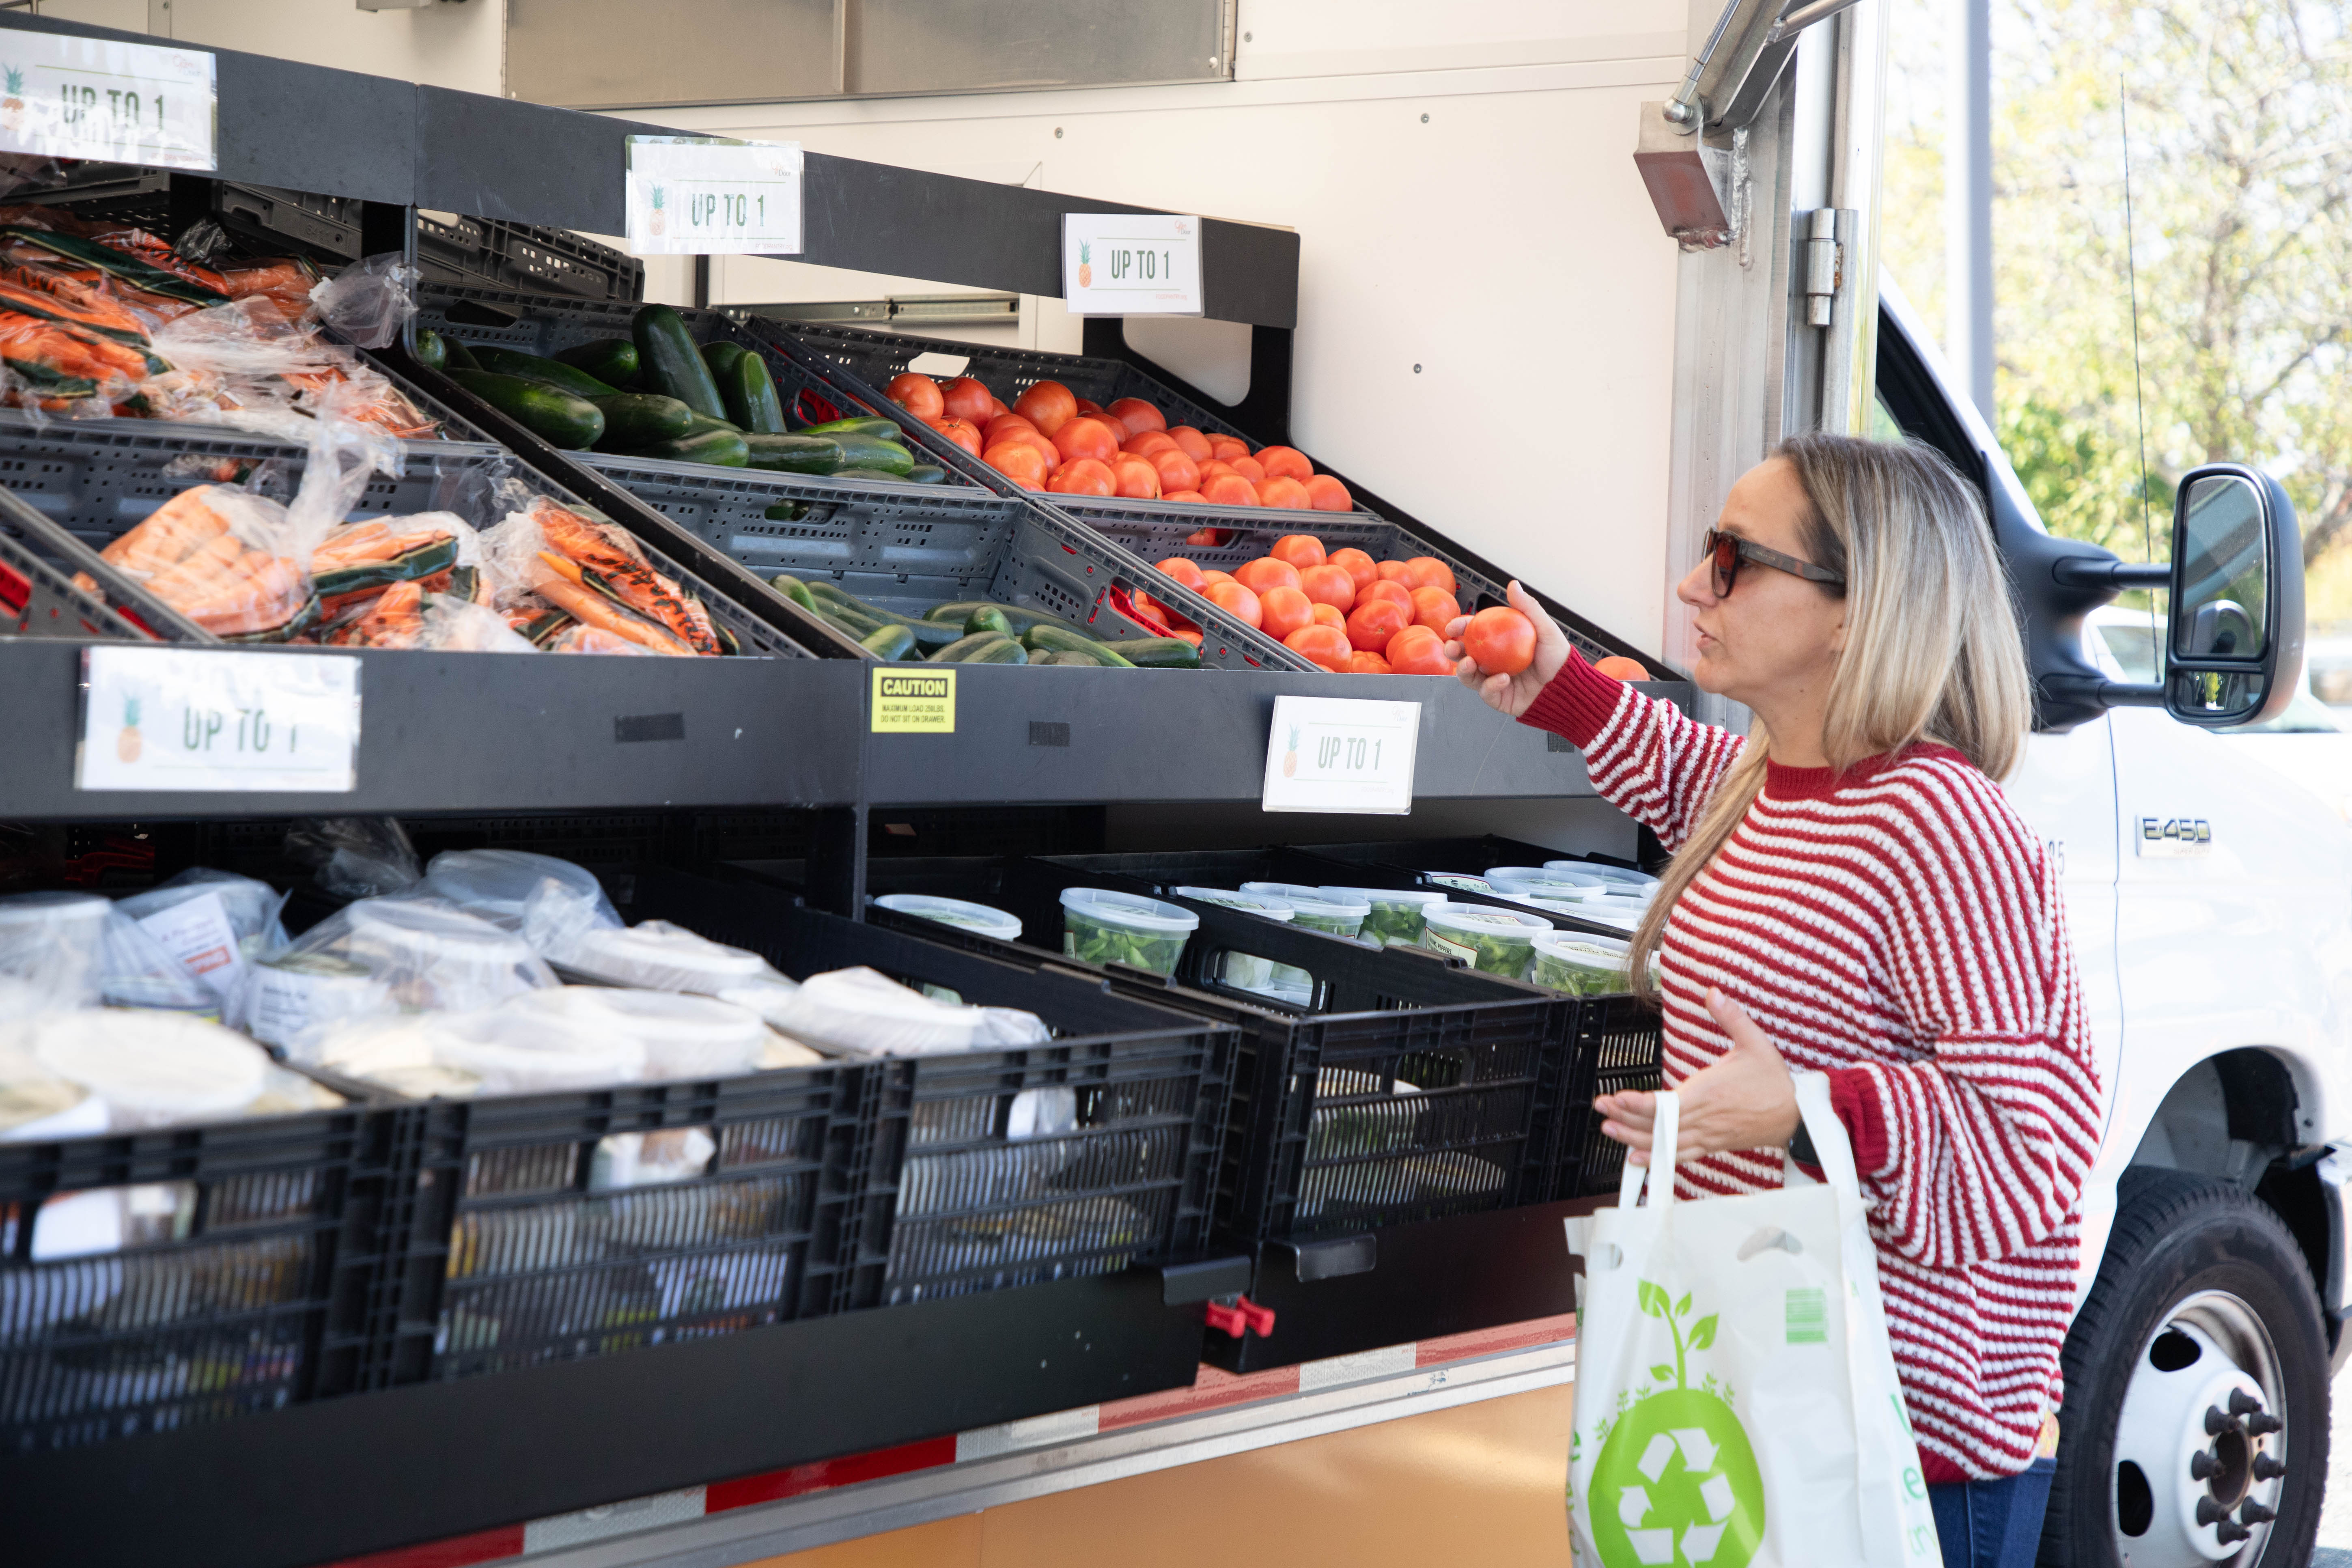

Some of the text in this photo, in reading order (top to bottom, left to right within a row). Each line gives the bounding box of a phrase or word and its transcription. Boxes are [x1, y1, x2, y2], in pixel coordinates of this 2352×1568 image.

[61, 84, 164, 131] UP TO 1
[692, 193, 765, 227] UP TO 1
[1111, 250, 1170, 279] UP TO 1
[883, 678, 946, 696] CAUTION
[183, 706, 297, 753] UP TO 1
[1318, 736, 1382, 771] UP TO 1
